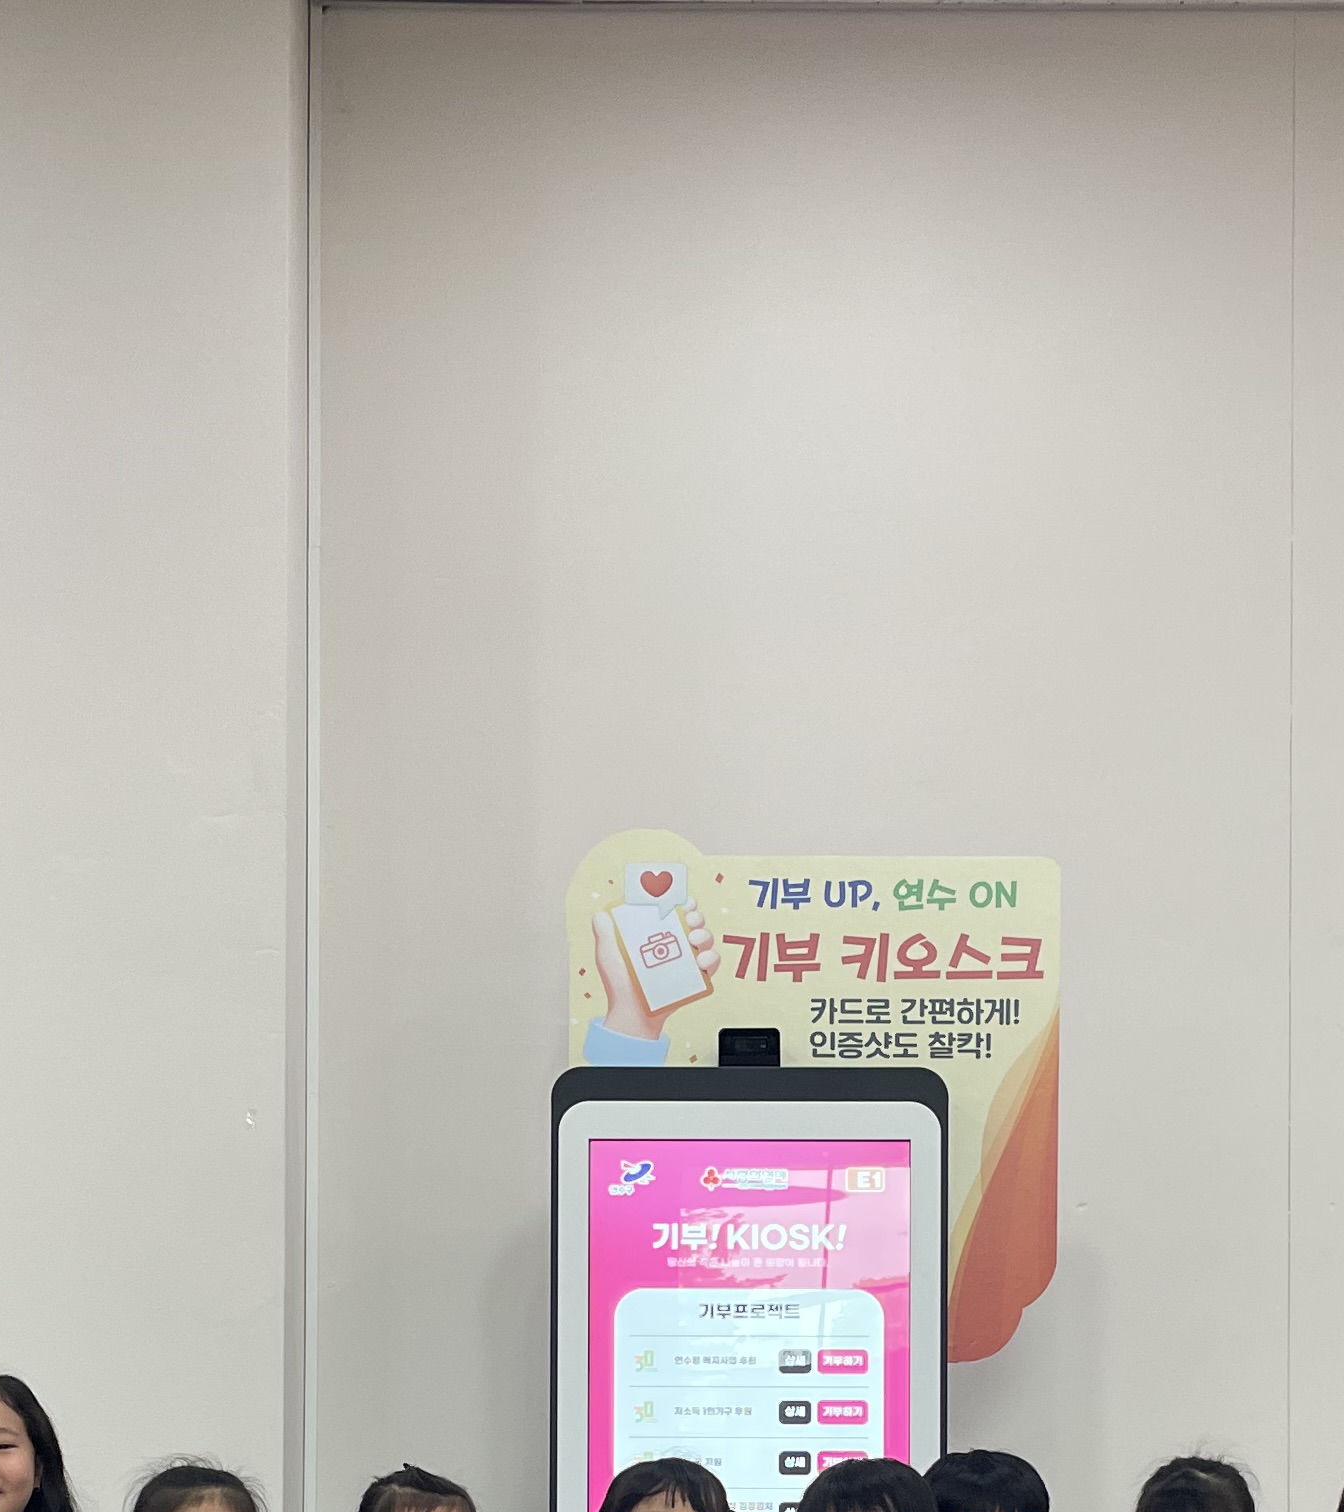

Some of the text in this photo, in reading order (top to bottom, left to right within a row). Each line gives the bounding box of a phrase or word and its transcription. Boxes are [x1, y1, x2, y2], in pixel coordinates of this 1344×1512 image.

[749, 878, 1018, 911] 기부 UP, 연수 ON
[722, 932, 1045, 982] 기부 키오스크
[809, 998, 1021, 1026] 카드로 간편하게!
[810, 1031, 992, 1060] 인증샷도 찰칵!
[856, 1171, 881, 1188] E1
[652, 1223, 847, 1251] 기부! KIOSK!
[699, 1304, 800, 1319] 기부프로젝트
[822, 1355, 863, 1367] 기부하기
[784, 1406, 806, 1418] 상세
[822, 1406, 863, 1418] 기부하기
[784, 1456, 806, 1468] 상세
